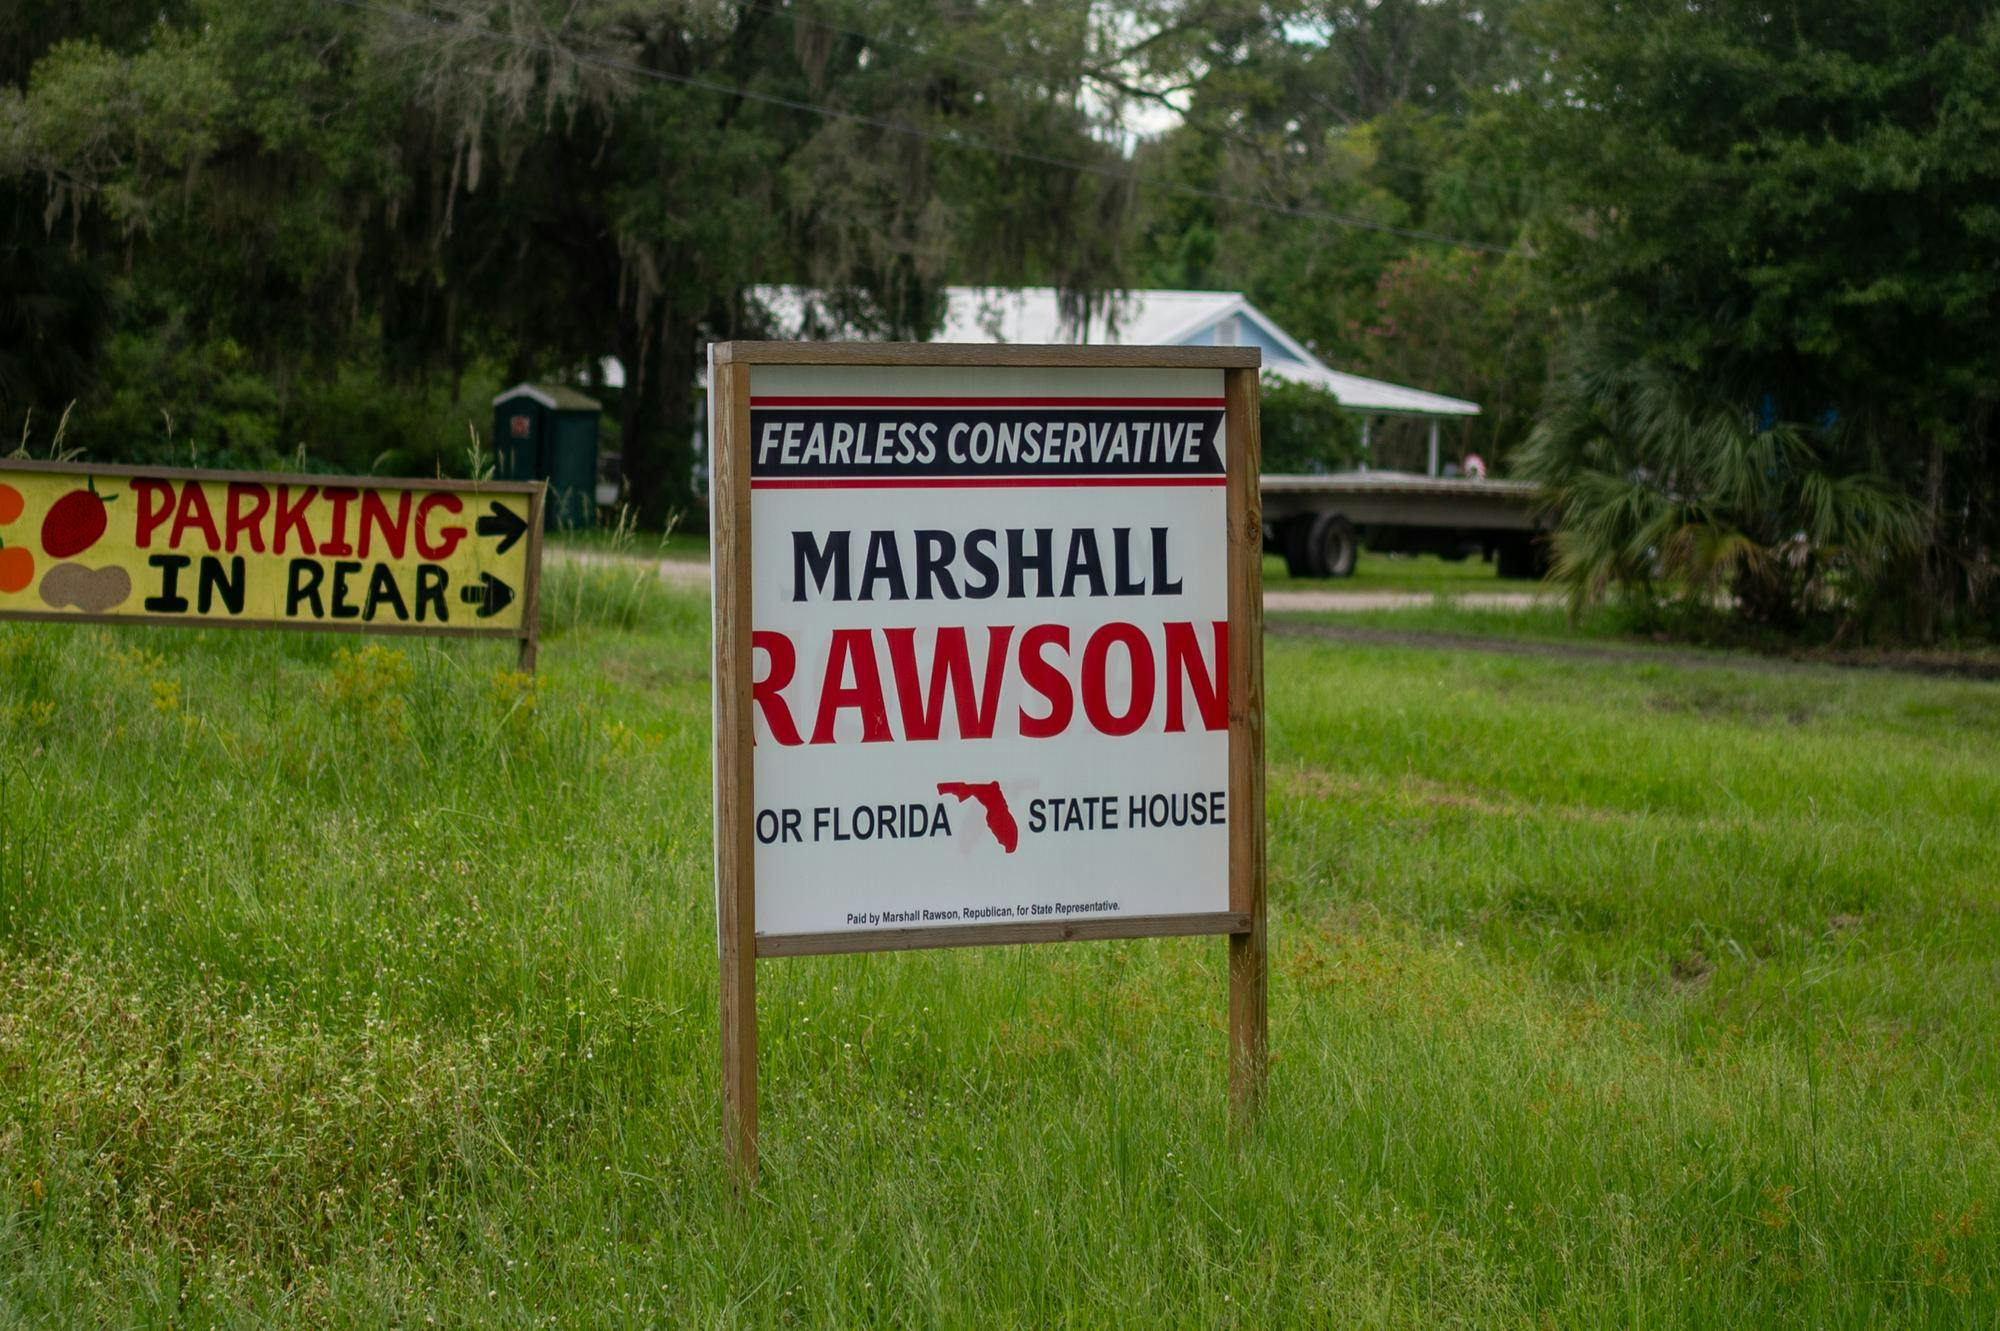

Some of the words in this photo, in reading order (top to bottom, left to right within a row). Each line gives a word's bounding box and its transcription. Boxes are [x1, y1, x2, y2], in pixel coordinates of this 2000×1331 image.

[758, 422, 938, 465] FEARLESS
[947, 422, 1204, 465] CONSERVATIVE
[129, 476, 468, 561] PARKING
[144, 554, 246, 615] IN
[286, 557, 450, 622] REAR
[791, 527, 1183, 602] MARSHALL
[752, 620, 1229, 747] RAWSON
[755, 808, 804, 845] OR
[813, 802, 952, 843] FLORIDA
[1027, 796, 1119, 833] STATE
[1128, 790, 1227, 829] HOUSE
[846, 912, 867, 925] Paid
[869, 912, 881, 926] by
[882, 909, 920, 923] Marshall
[922, 908, 961, 921] Rawson,
[963, 905, 1015, 920] Republican,
[1017, 904, 1029, 917] for
[1031, 903, 1053, 916] State
[1055, 900, 1120, 915] Representative.
